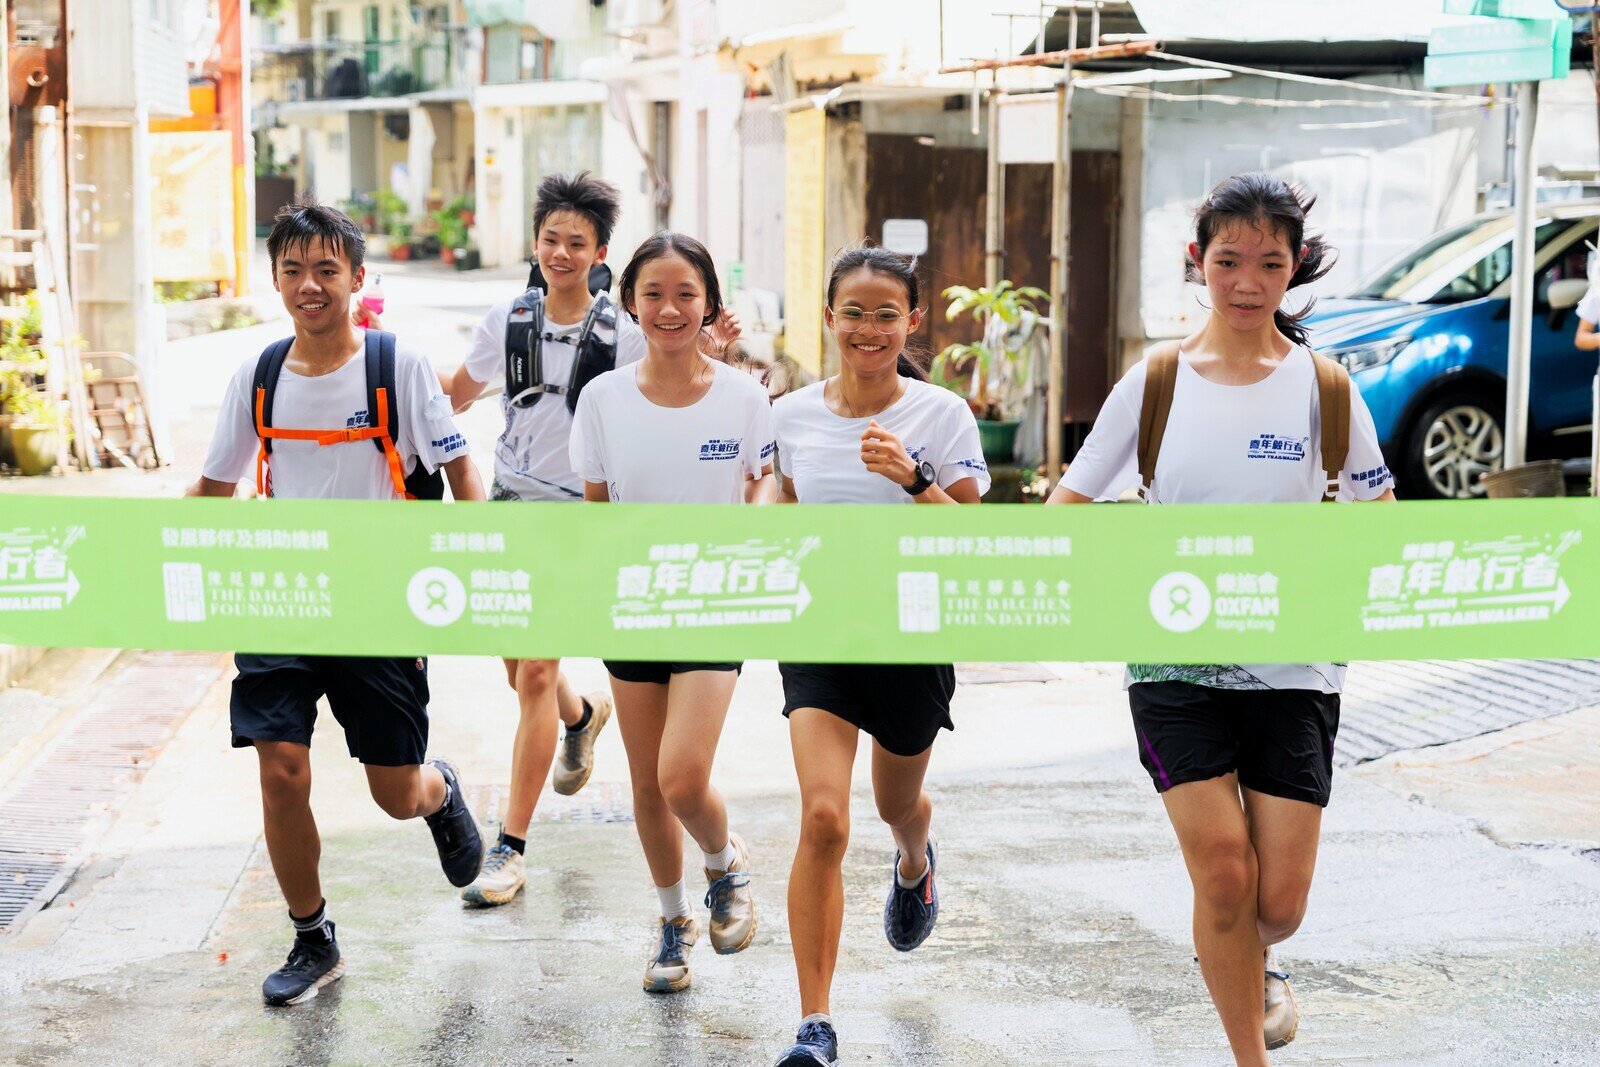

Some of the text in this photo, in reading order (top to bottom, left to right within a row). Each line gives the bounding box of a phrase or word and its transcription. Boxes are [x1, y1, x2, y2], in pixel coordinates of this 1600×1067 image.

[209, 588, 245, 602] THE
[469, 592, 533, 612] OXFAM
[210, 603, 333, 618] FOUNDATION
[945, 597, 979, 611] THE
[1215, 596, 1280, 616] OXFAM
[471, 613, 529, 628] Hong Kong
[612, 608, 793, 630] YOUNG TRAILWALKER
[944, 612, 1072, 626] FOUNDATION
[1215, 617, 1277, 634] Hong Kong
[1362, 605, 1550, 632] YOUNG TRAILWALKER
